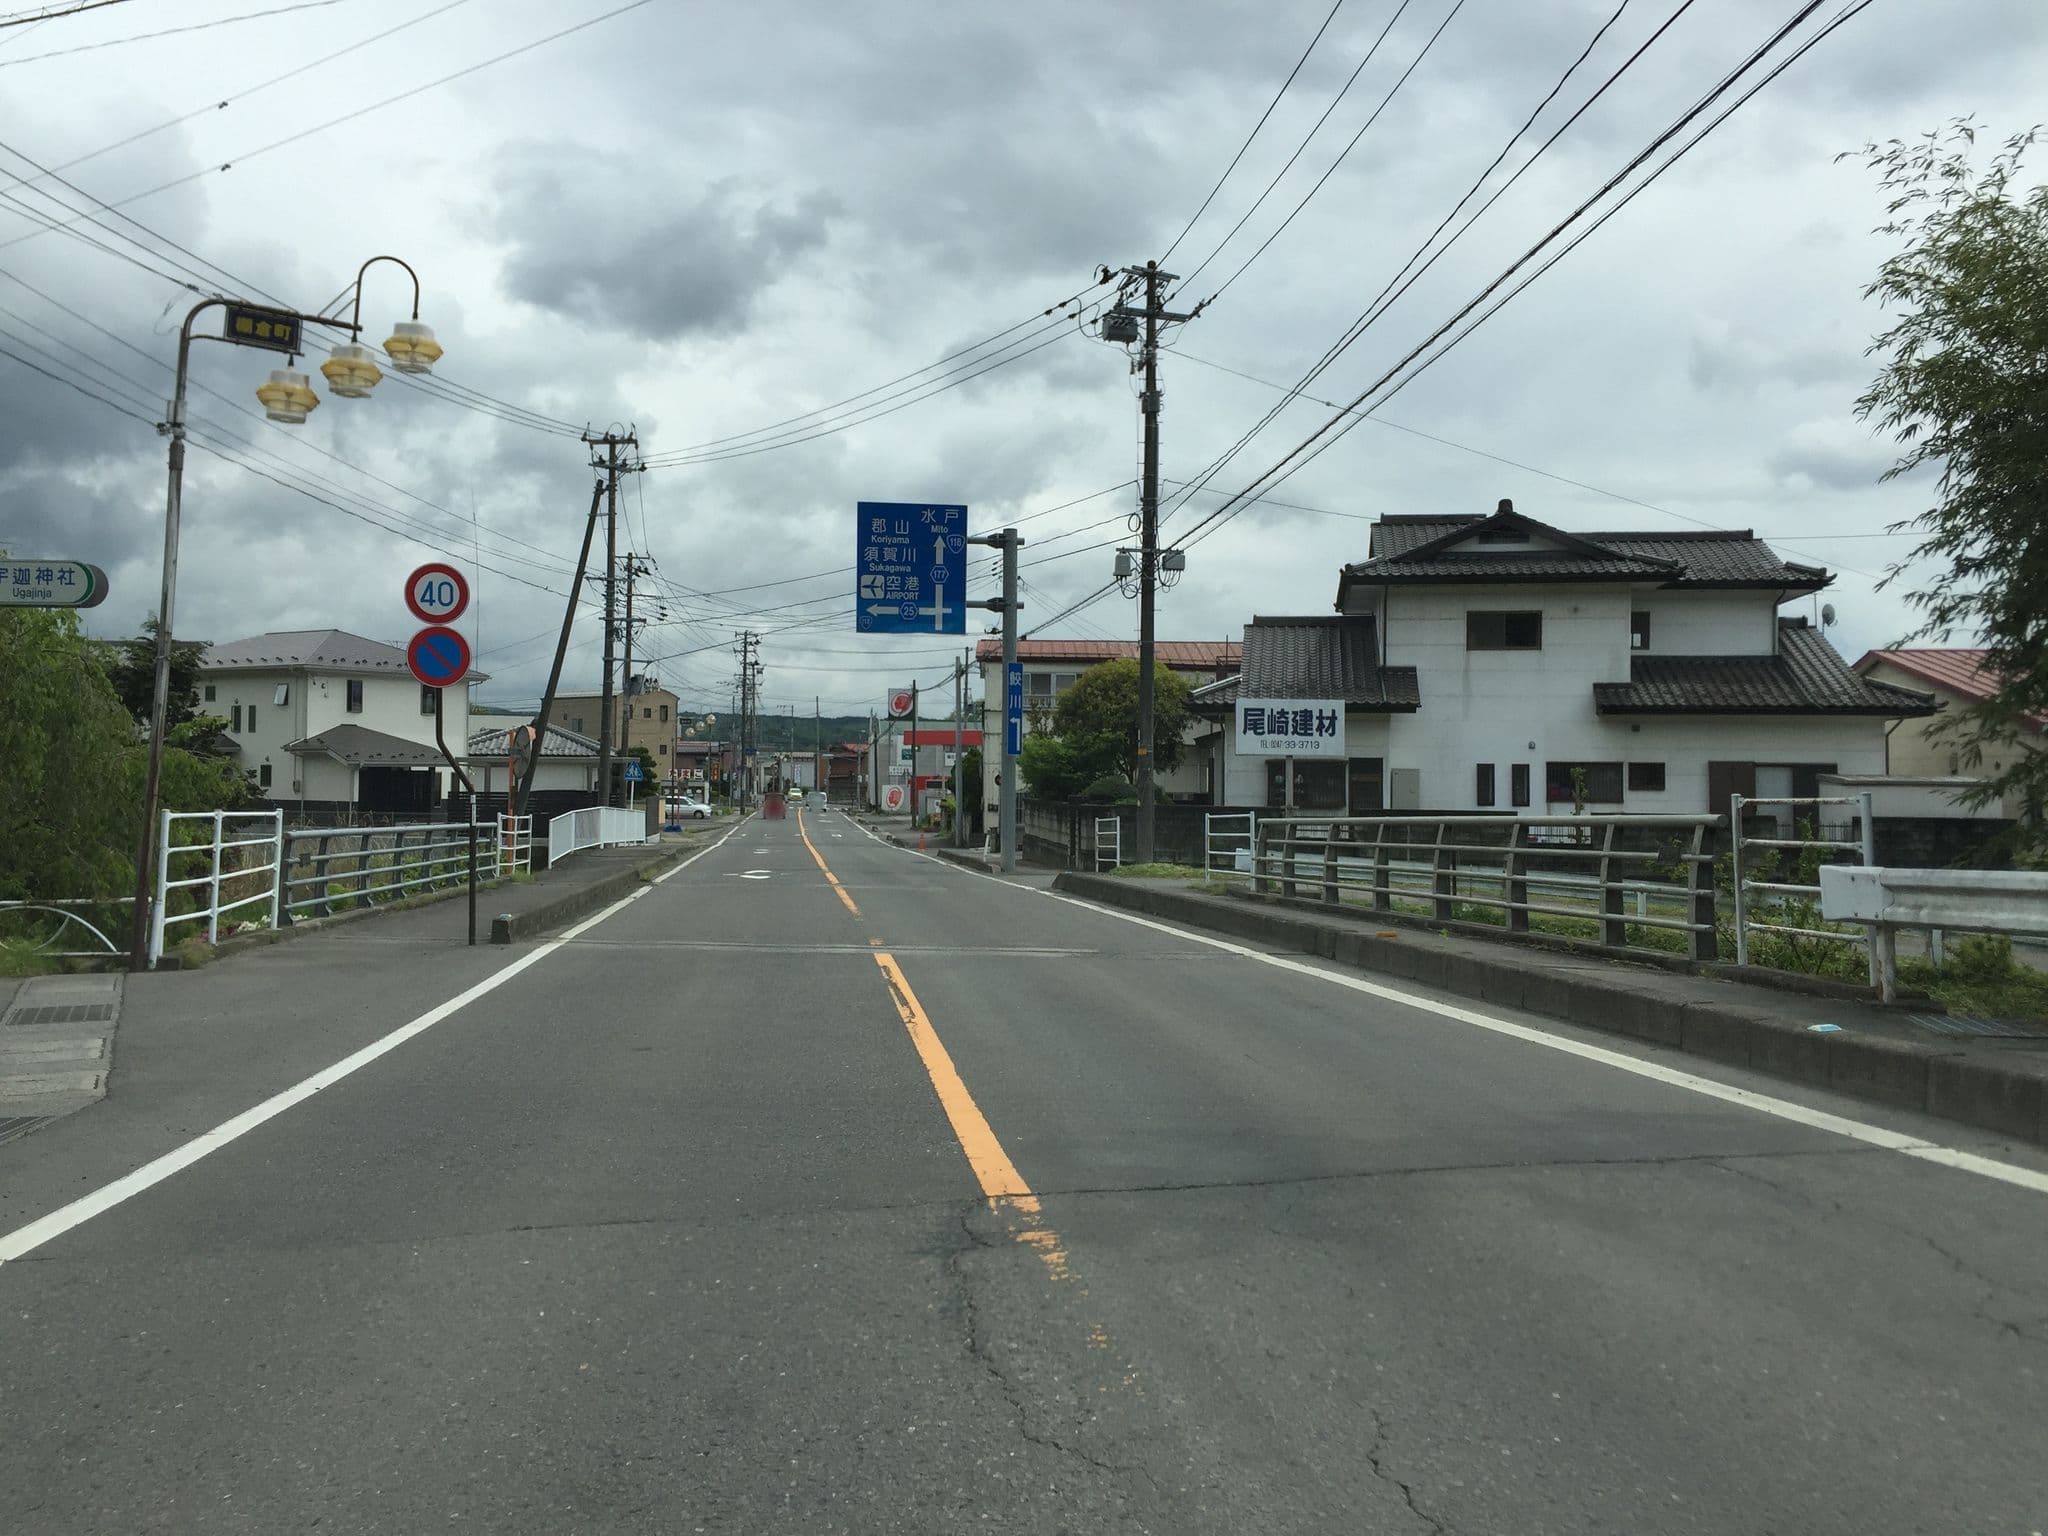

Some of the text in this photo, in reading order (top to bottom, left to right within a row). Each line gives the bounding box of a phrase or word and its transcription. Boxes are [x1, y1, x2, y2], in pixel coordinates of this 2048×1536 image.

[921, 509, 959, 524] 水戸
[872, 518, 909, 534] 郡山
[931, 525, 948, 533] Mito
[871, 535, 910, 545] Koriyama
[950, 537, 962, 547] 118
[864, 546, 916, 562] 須賀川
[869, 563, 911, 573] Sukagawa
[934, 570, 946, 579] 177
[886, 576, 919, 591] 空港
[12, 588, 52, 599] Ugajinja
[420, 581, 454, 606] 40
[886, 591, 919, 600] AIRPORT
[903, 606, 915, 616] 25
[1243, 708, 1338, 737] 尾崎建材
